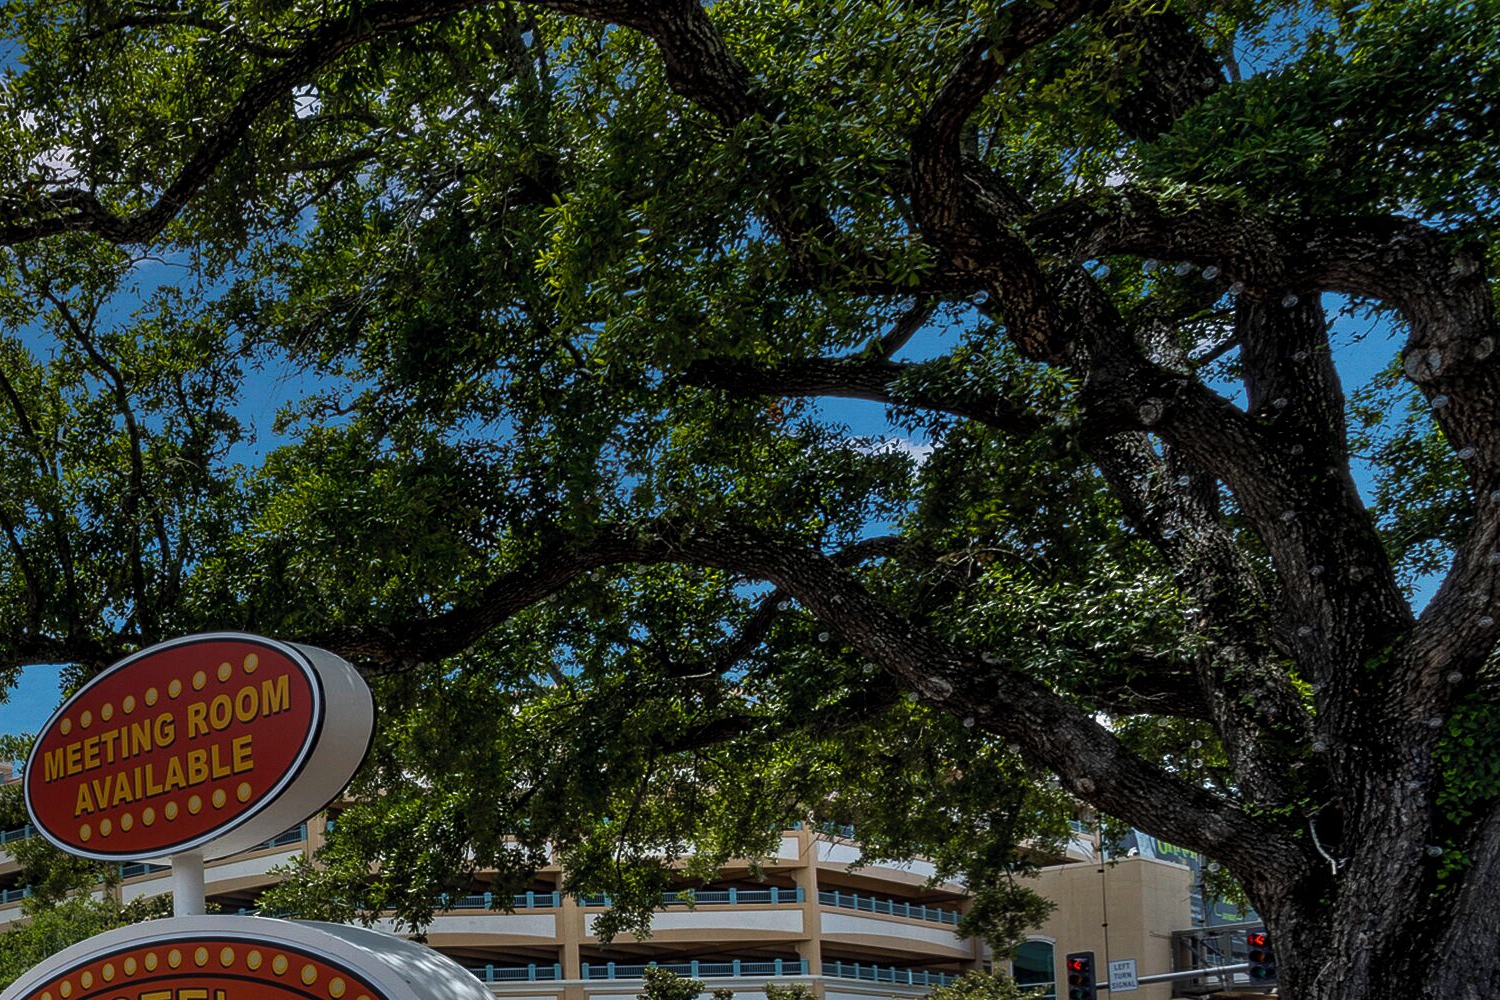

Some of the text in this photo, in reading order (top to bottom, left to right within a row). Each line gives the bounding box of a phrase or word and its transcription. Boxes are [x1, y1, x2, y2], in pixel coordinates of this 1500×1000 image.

[44, 674, 291, 783] MEETING ROOM
[74, 734, 254, 817] AVAILABLE
[1113, 962, 1131, 971] LEFT
[1113, 972, 1132, 980] TURN
